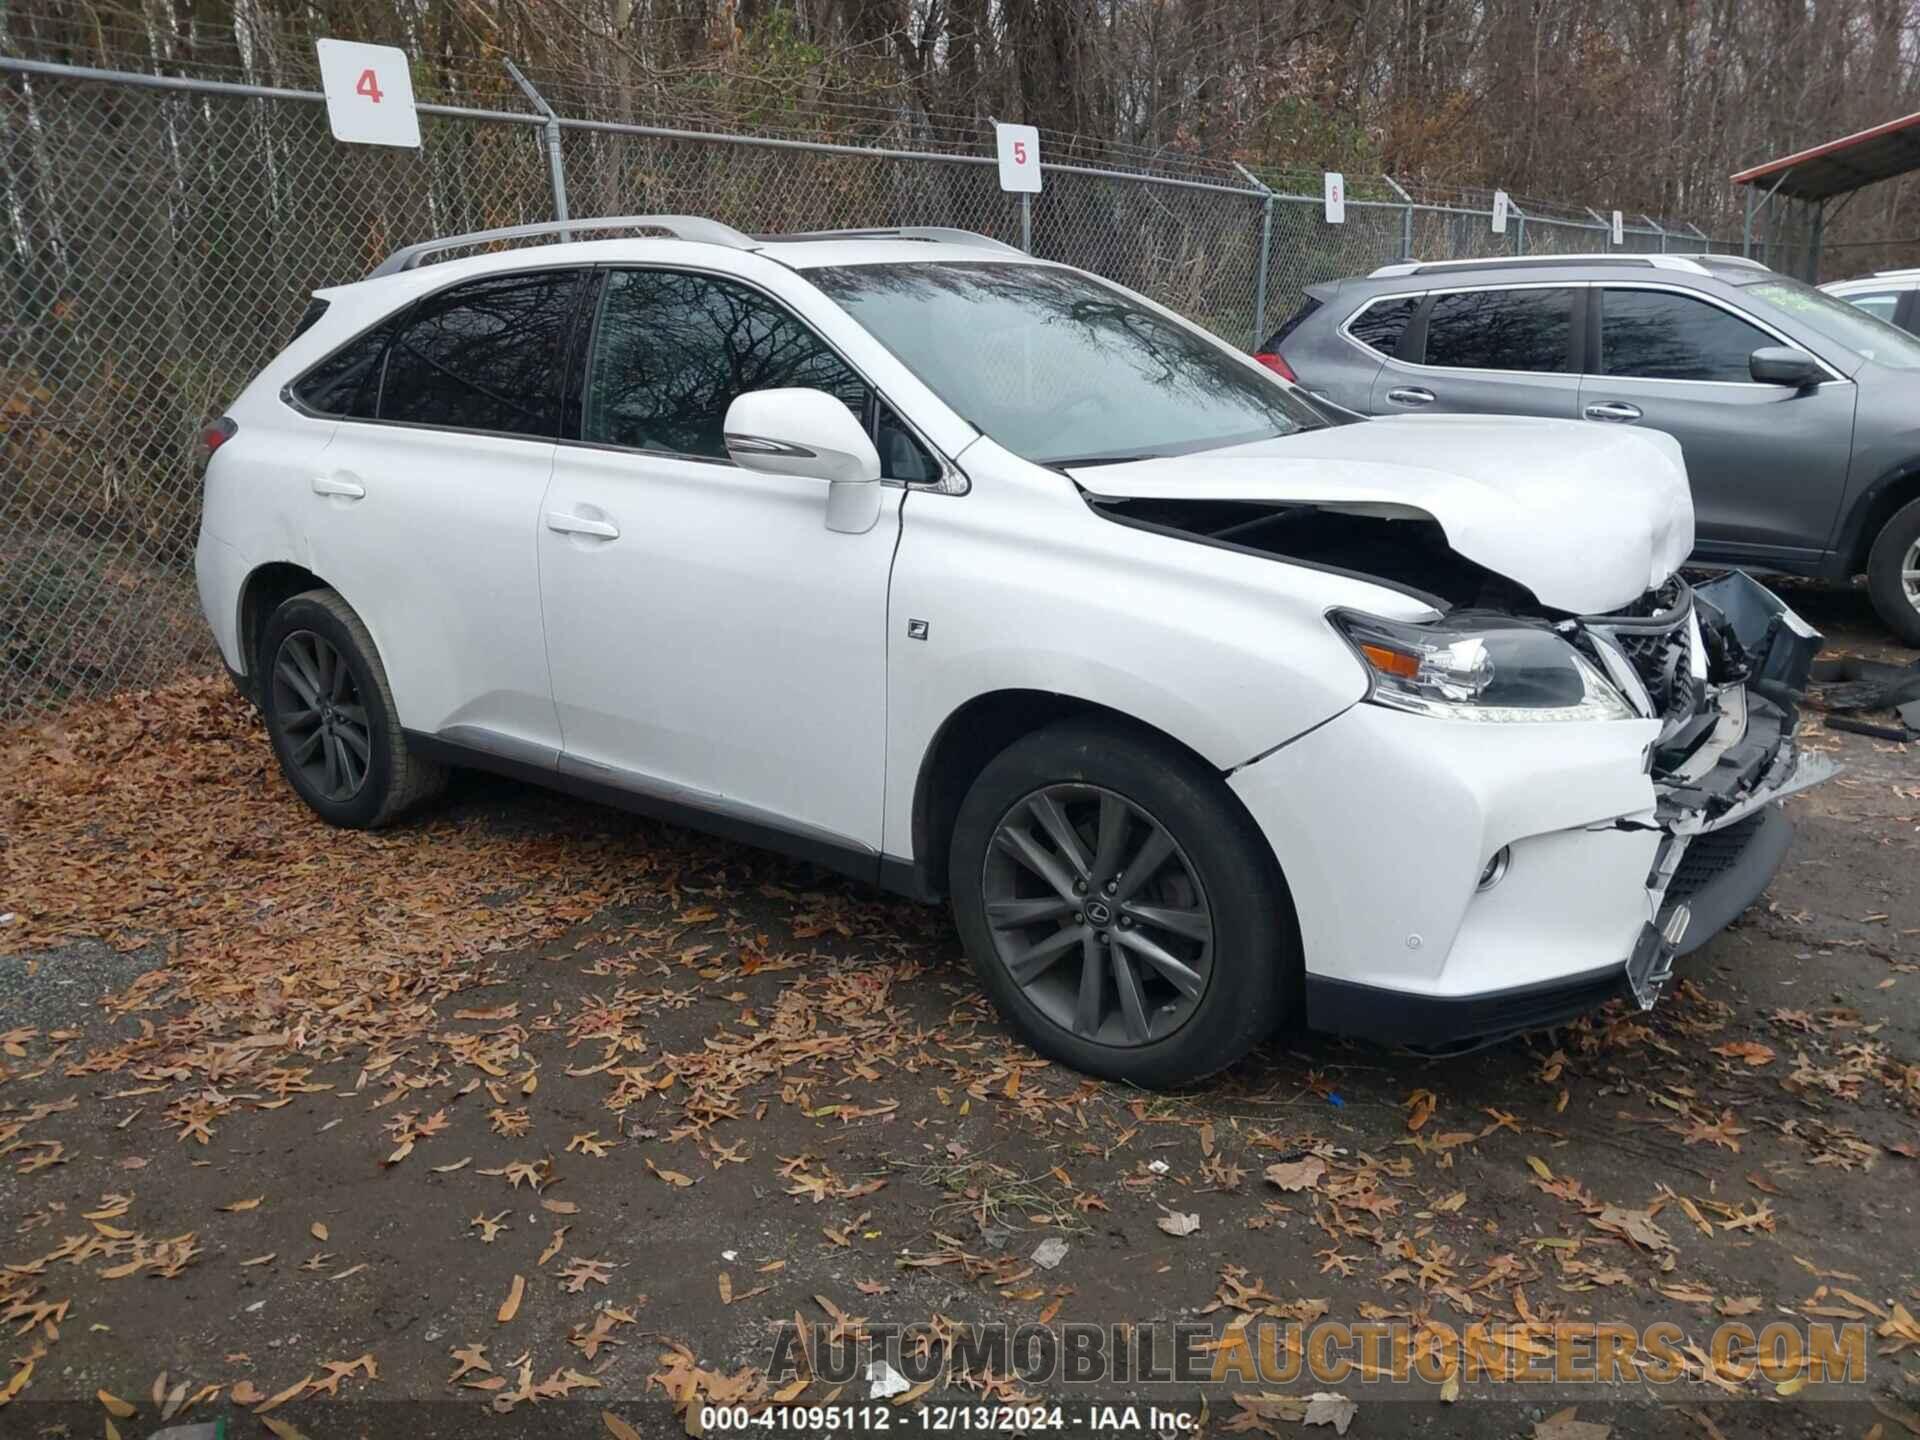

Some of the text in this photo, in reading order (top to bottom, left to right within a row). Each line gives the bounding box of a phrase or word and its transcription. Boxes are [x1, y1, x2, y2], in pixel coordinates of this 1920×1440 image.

[356, 69, 384, 104] 4
[1014, 142, 1027, 165] 5
[1332, 185, 1338, 203] 6
